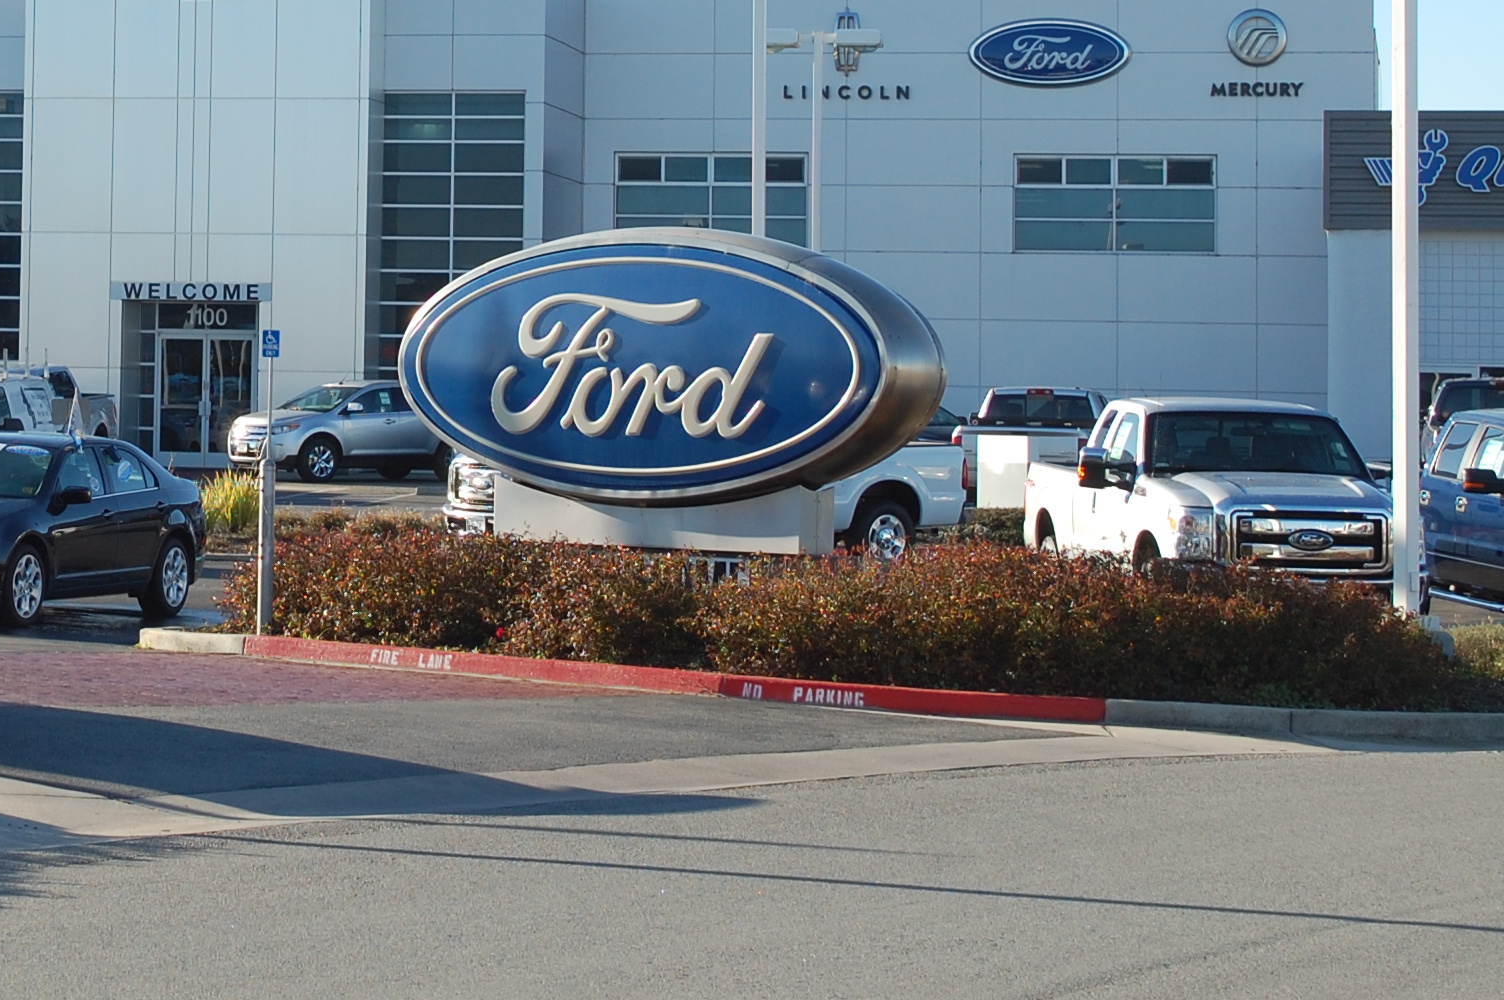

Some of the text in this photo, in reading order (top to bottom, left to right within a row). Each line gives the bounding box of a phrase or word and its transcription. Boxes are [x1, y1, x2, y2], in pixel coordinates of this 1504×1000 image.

[1004, 34, 1094, 71] Ford
[783, 84, 911, 101] LINCOLN
[1210, 81, 1304, 98] MERCURY
[123, 282, 260, 301] WELCOME
[186, 307, 228, 327] 1100
[491, 292, 775, 440] Ford
[371, 648, 453, 669] FIRE LANE
[742, 681, 865, 706] NO PARKING
